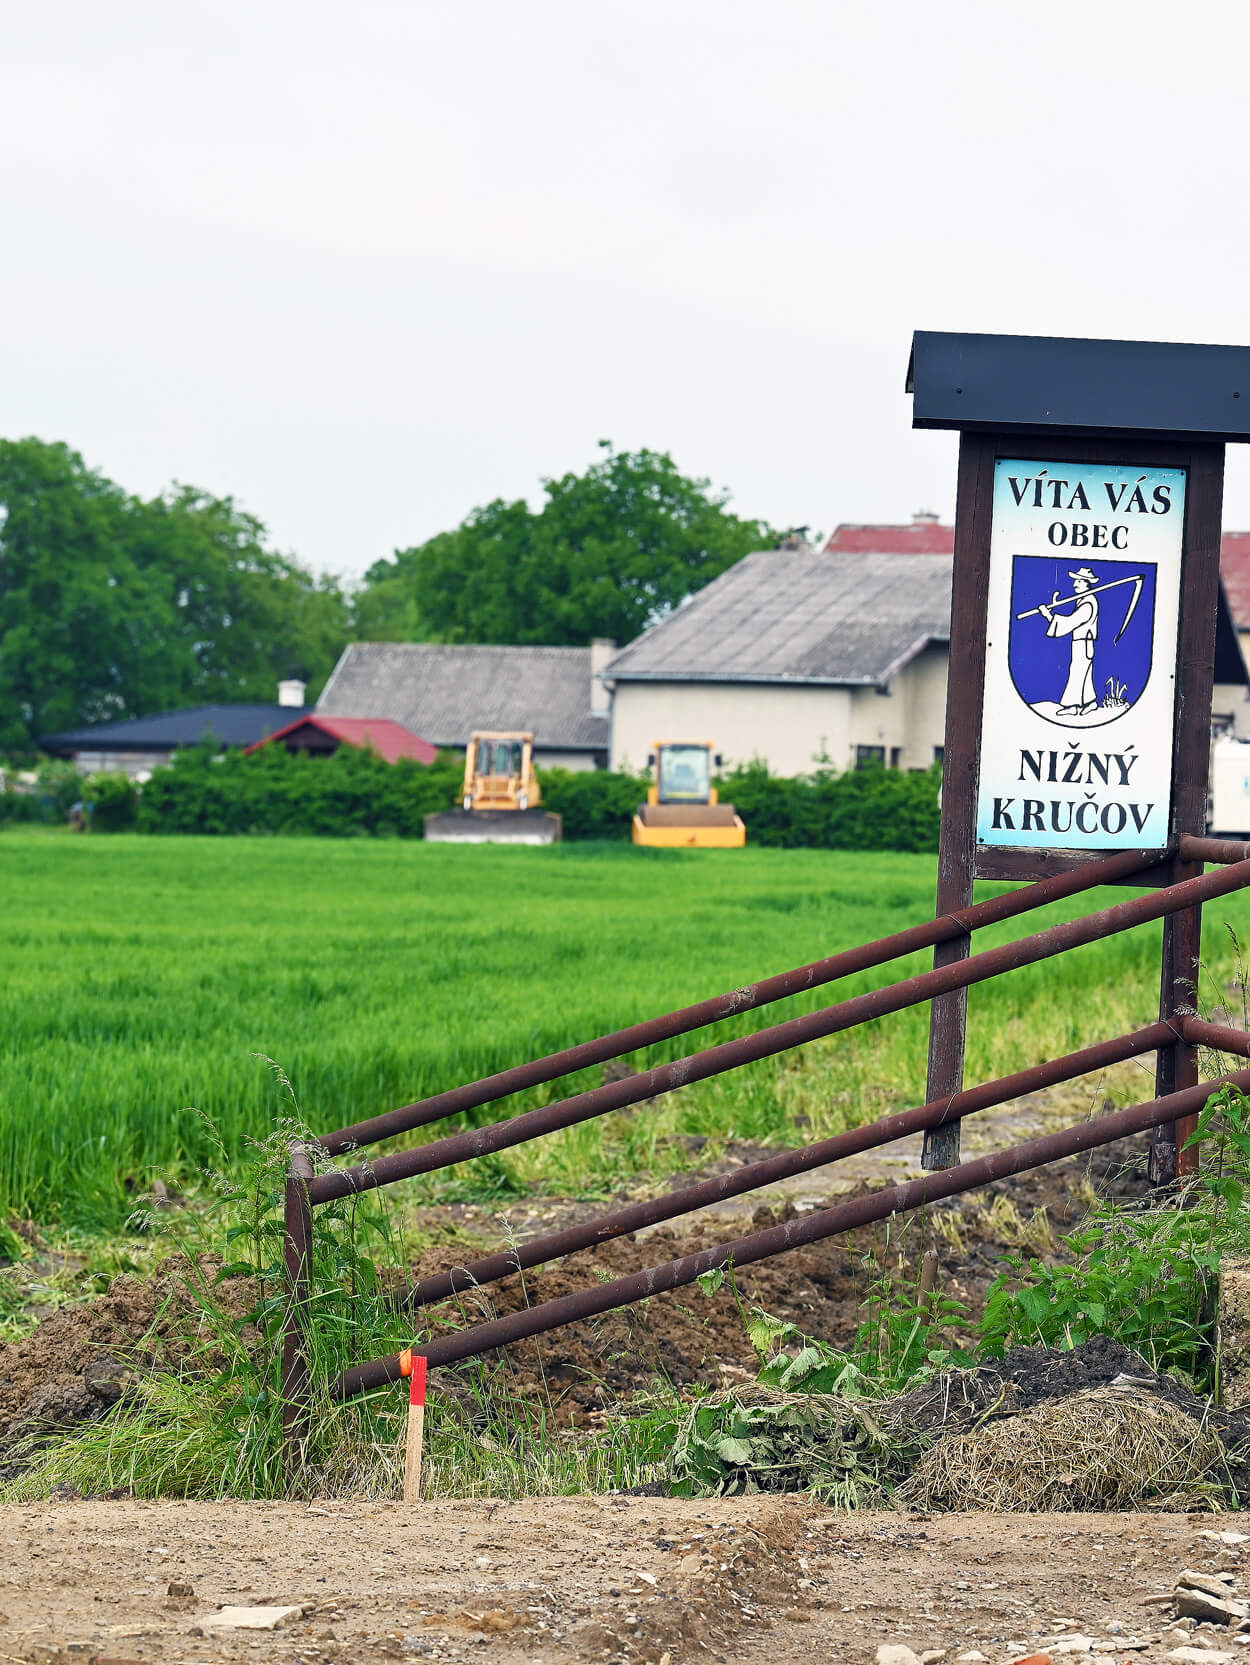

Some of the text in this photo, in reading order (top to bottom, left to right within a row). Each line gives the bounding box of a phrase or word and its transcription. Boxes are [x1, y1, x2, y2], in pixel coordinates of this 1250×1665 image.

[1008, 469, 1171, 514] VÍTA VÁS
[1048, 522, 1129, 549] OBEC
[1017, 741, 1139, 786] NIŽNÝ
[991, 792, 1155, 834] KRUČOV
